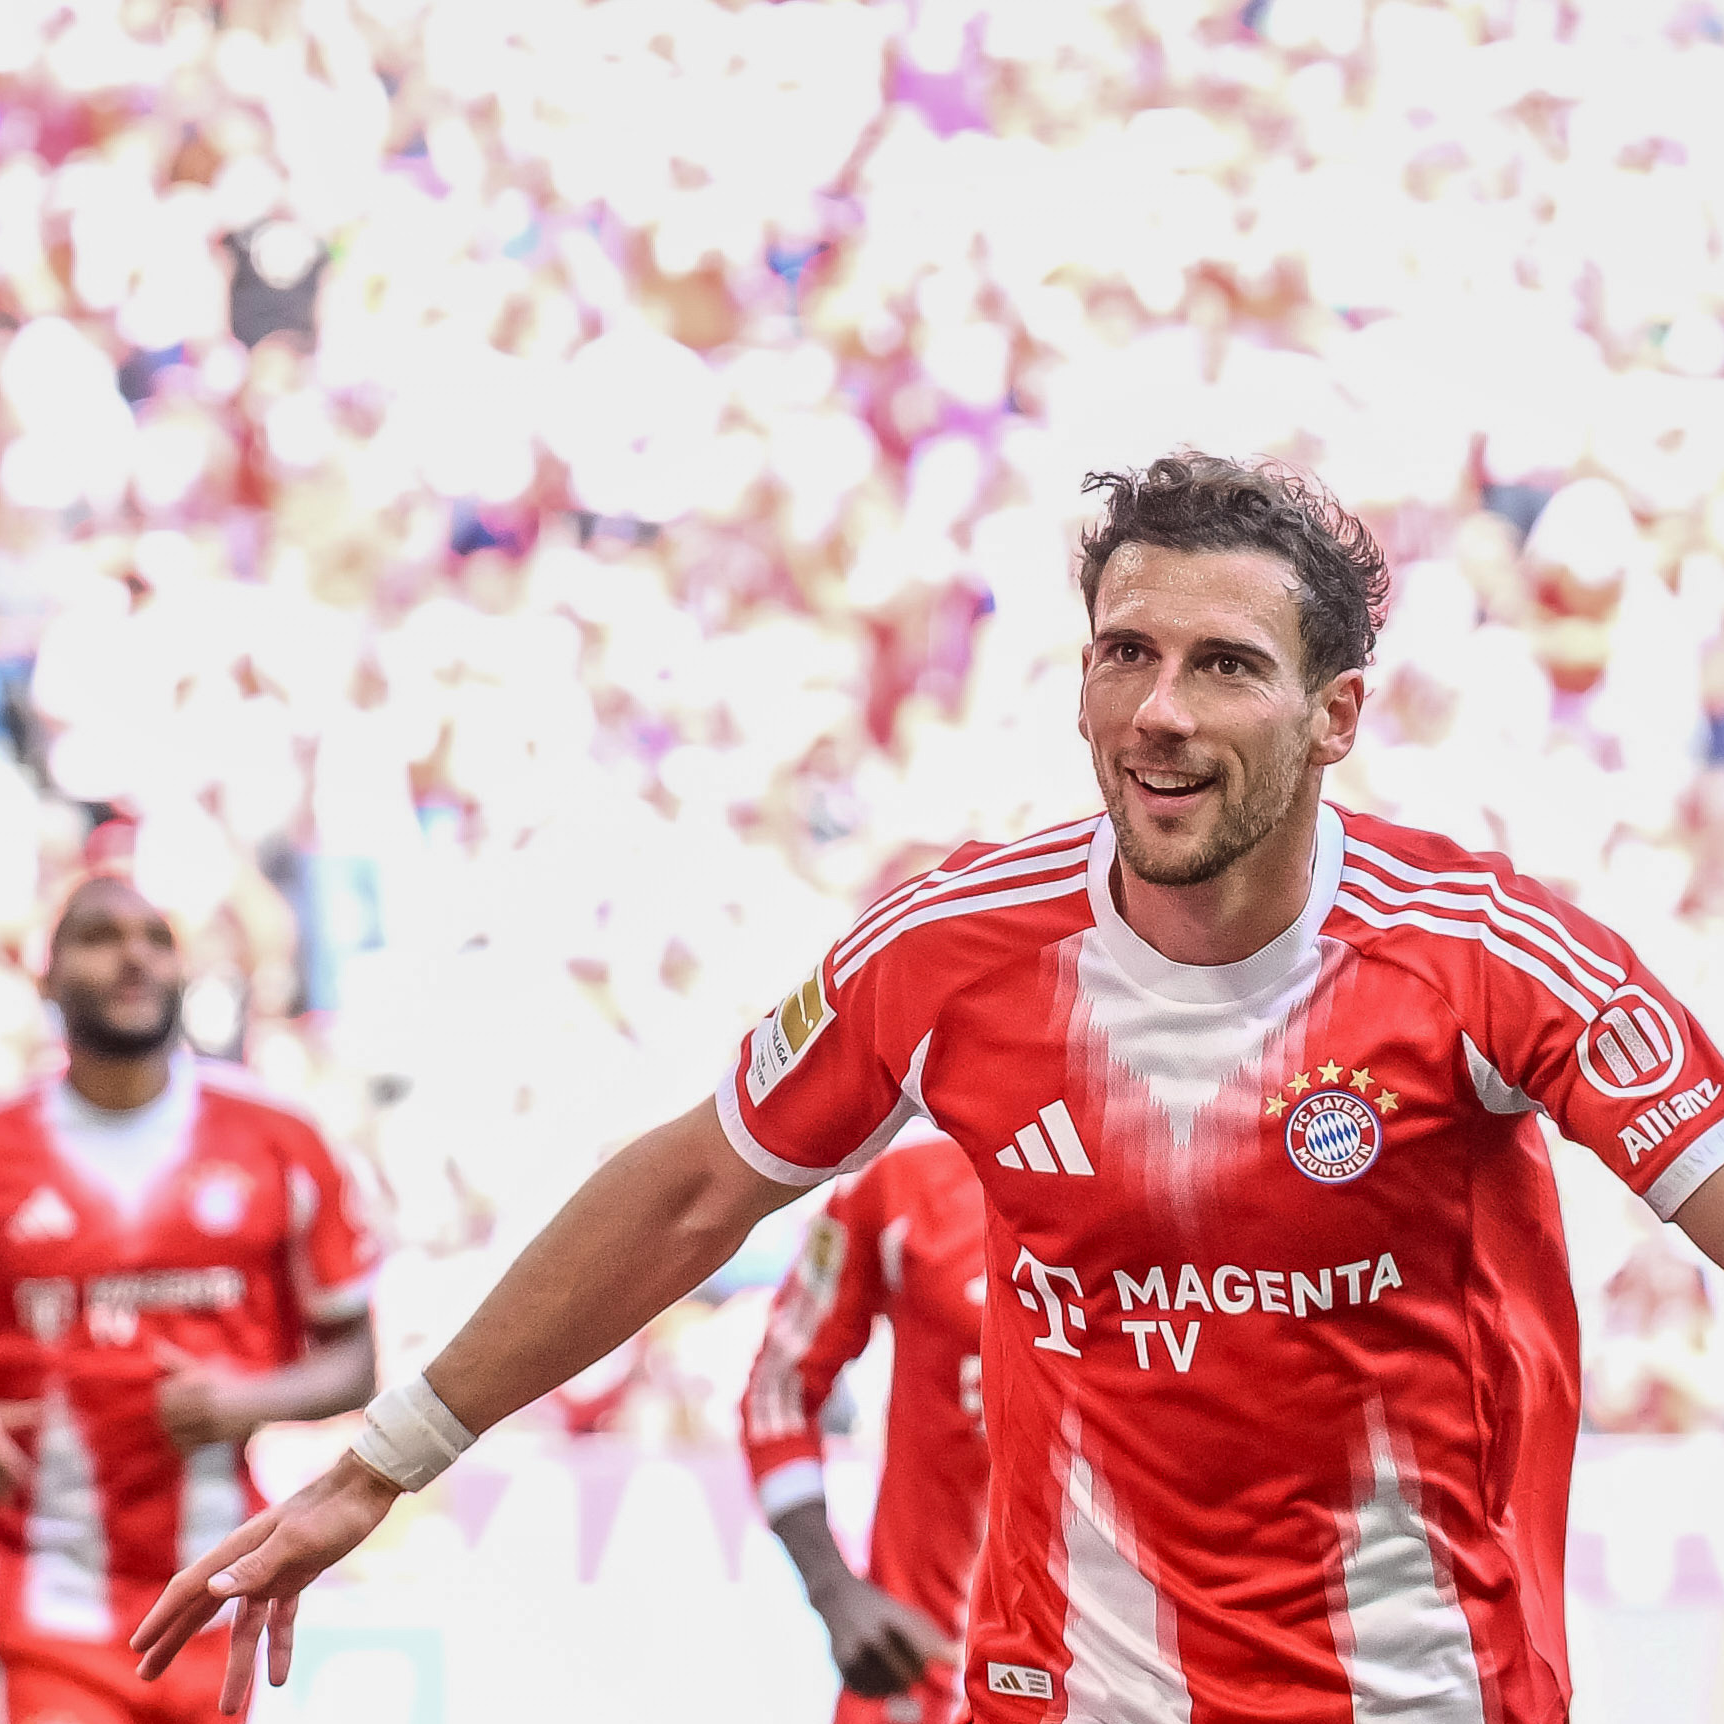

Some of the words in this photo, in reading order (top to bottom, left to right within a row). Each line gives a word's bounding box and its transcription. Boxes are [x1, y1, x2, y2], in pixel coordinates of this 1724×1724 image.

[1293, 1109, 1311, 1133] FC
[1309, 1097, 1372, 1130] BAYERN
[1617, 1077, 1723, 1166] Allianz
[1012, 1245, 1086, 1359] T
[1112, 1252, 1403, 1319] MAGENTA
[1121, 1319, 1201, 1373] TV
